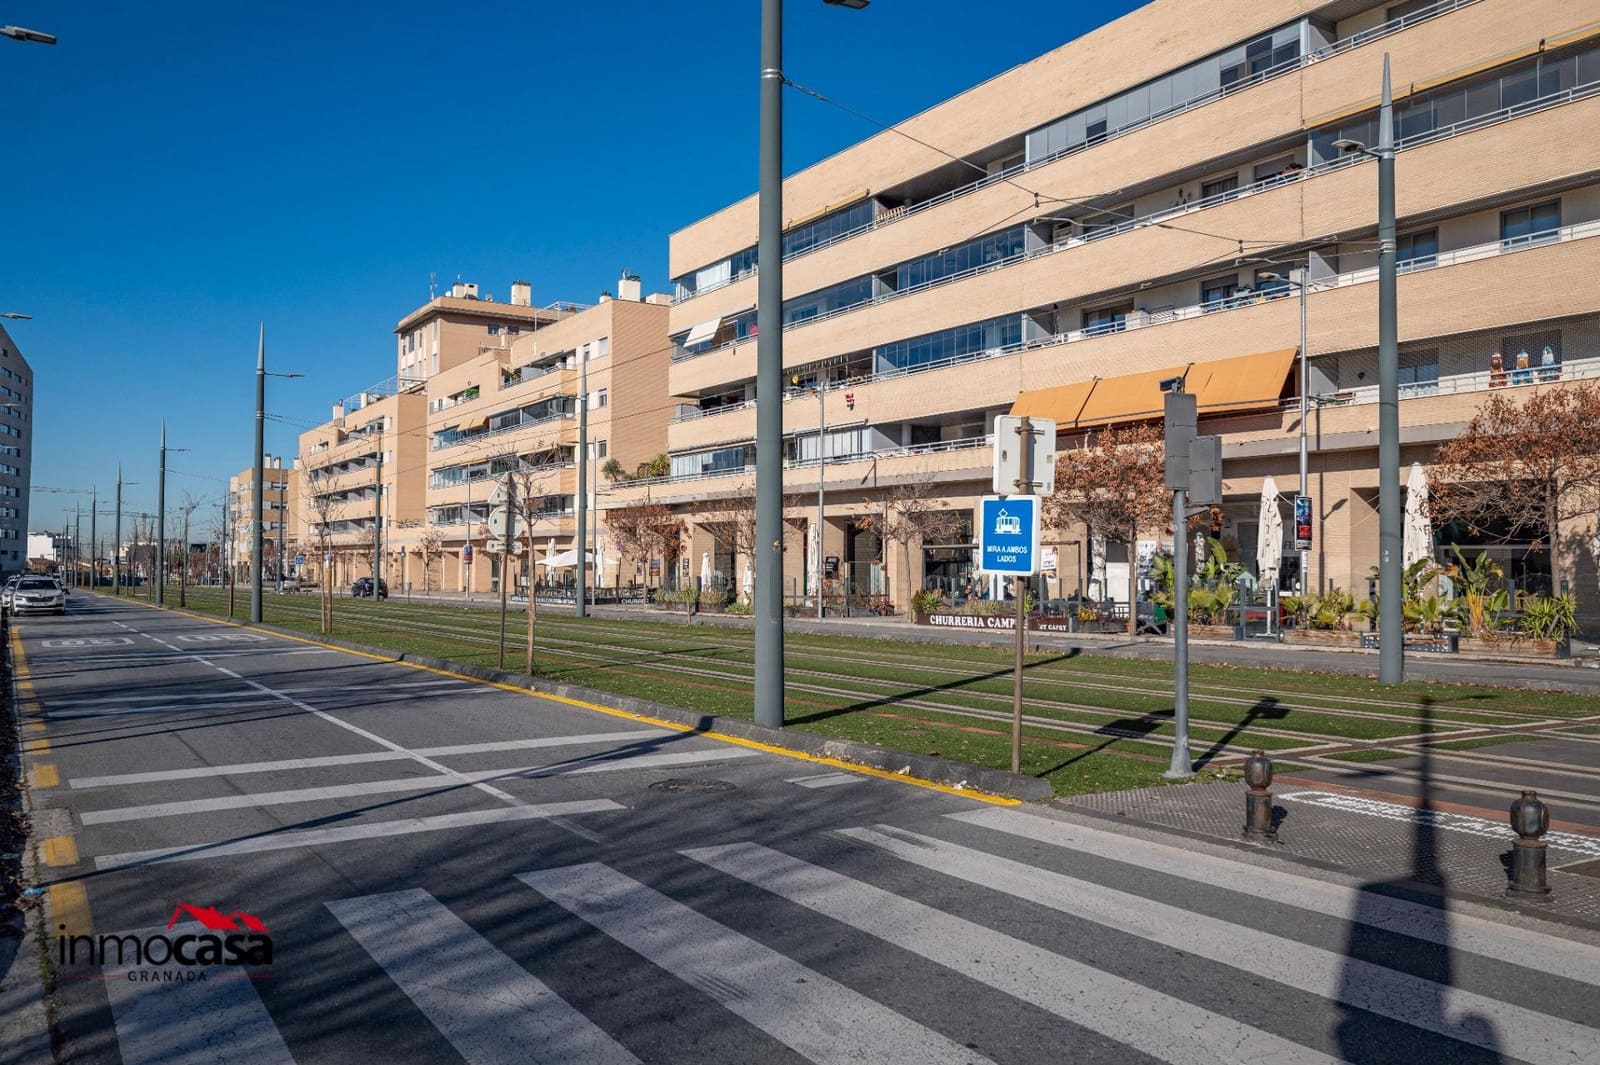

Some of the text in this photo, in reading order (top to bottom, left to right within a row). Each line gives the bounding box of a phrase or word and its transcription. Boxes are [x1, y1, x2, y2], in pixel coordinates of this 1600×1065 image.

[1007, 546, 1028, 554] AMBOS
[996, 555, 1017, 563] LADOS
[929, 615, 985, 628] CHURRERIA
